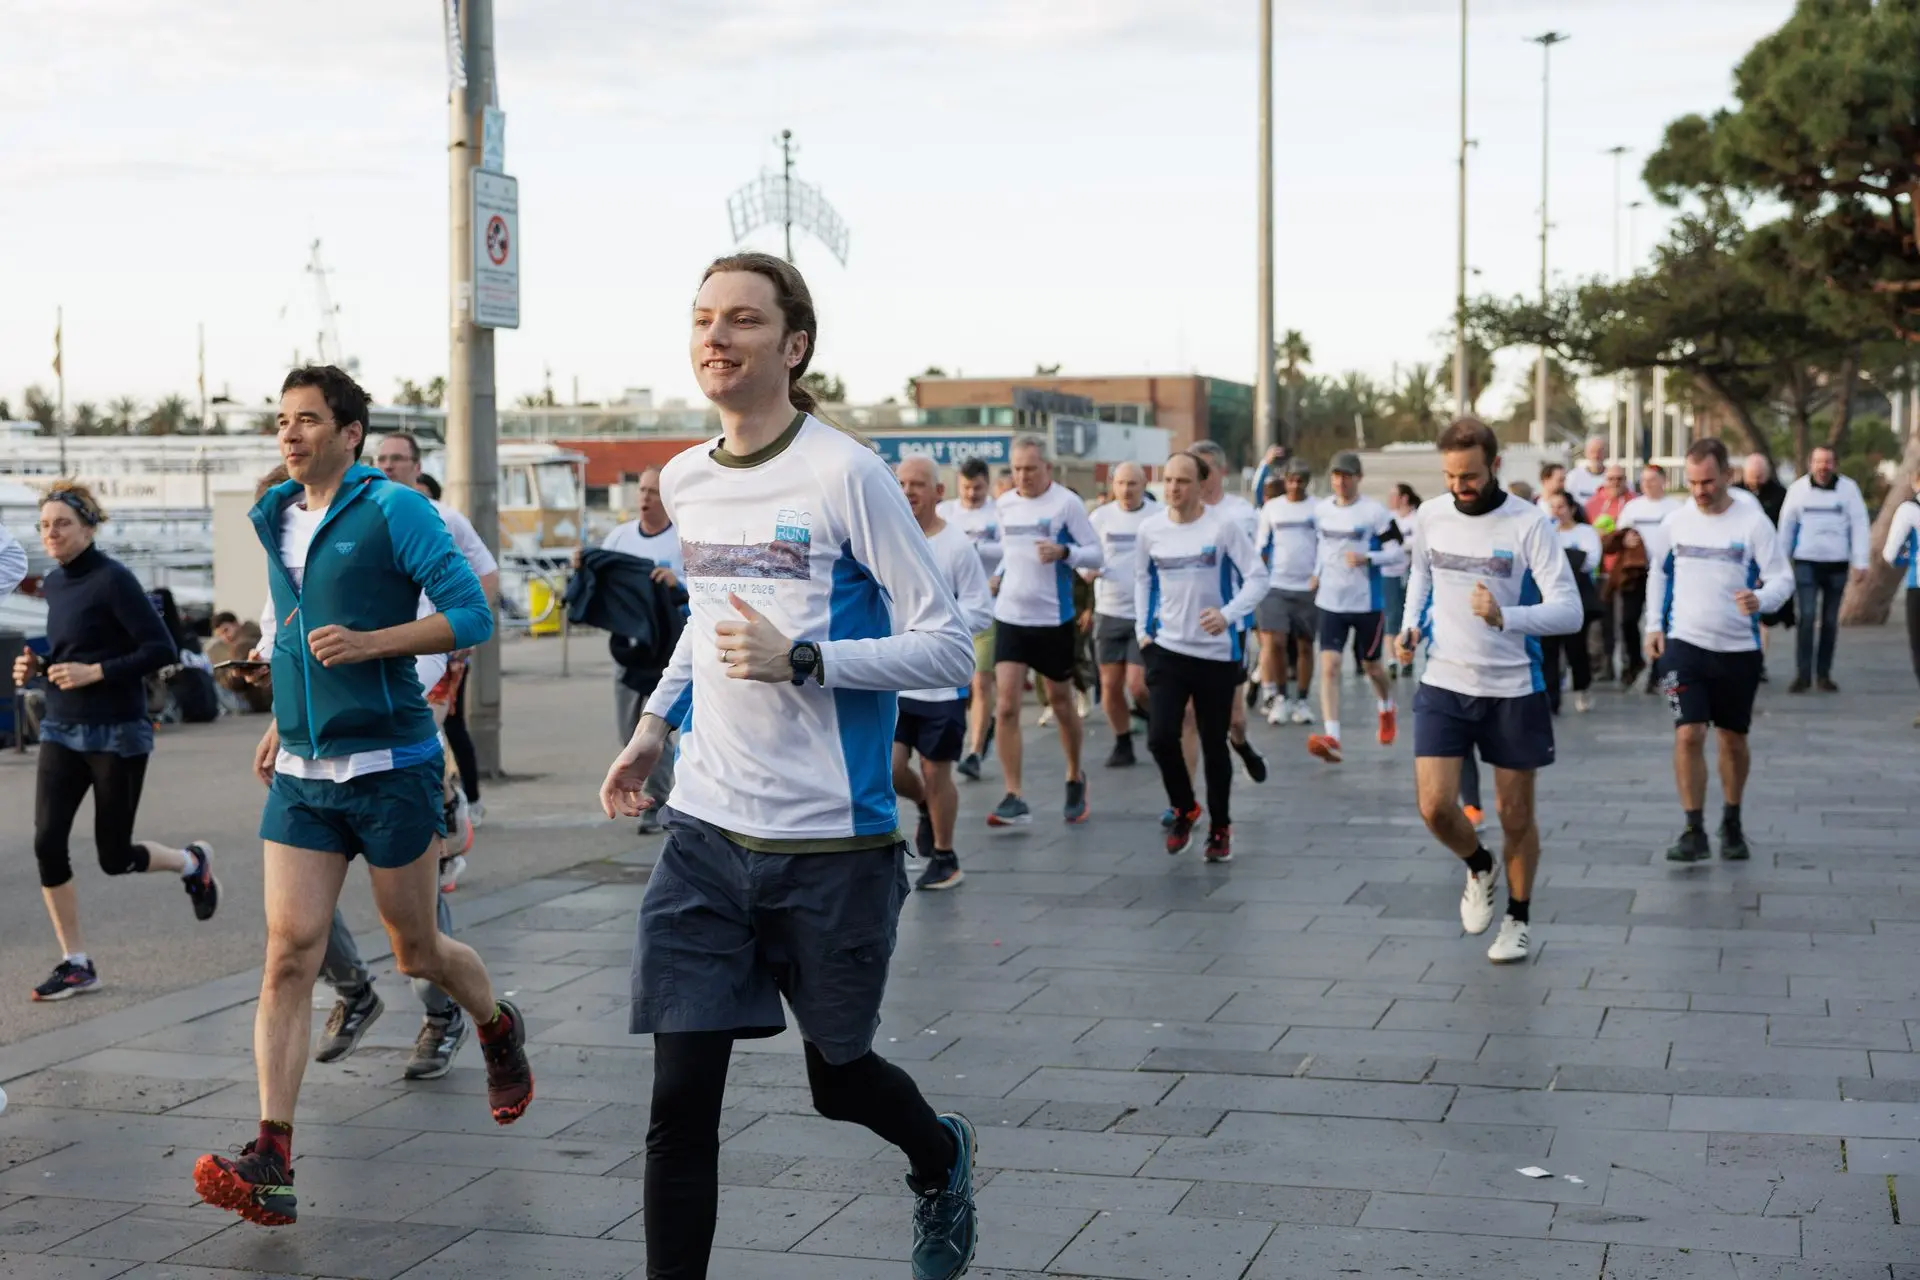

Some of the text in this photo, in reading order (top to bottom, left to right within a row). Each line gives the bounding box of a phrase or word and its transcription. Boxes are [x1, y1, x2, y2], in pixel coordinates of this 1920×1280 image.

[946, 441, 1004, 459] TOURS
[778, 510, 812, 526] EPIC
[778, 527, 806, 542] RUN
[720, 583, 747, 593] AGM
[751, 583, 775, 595] 2025
